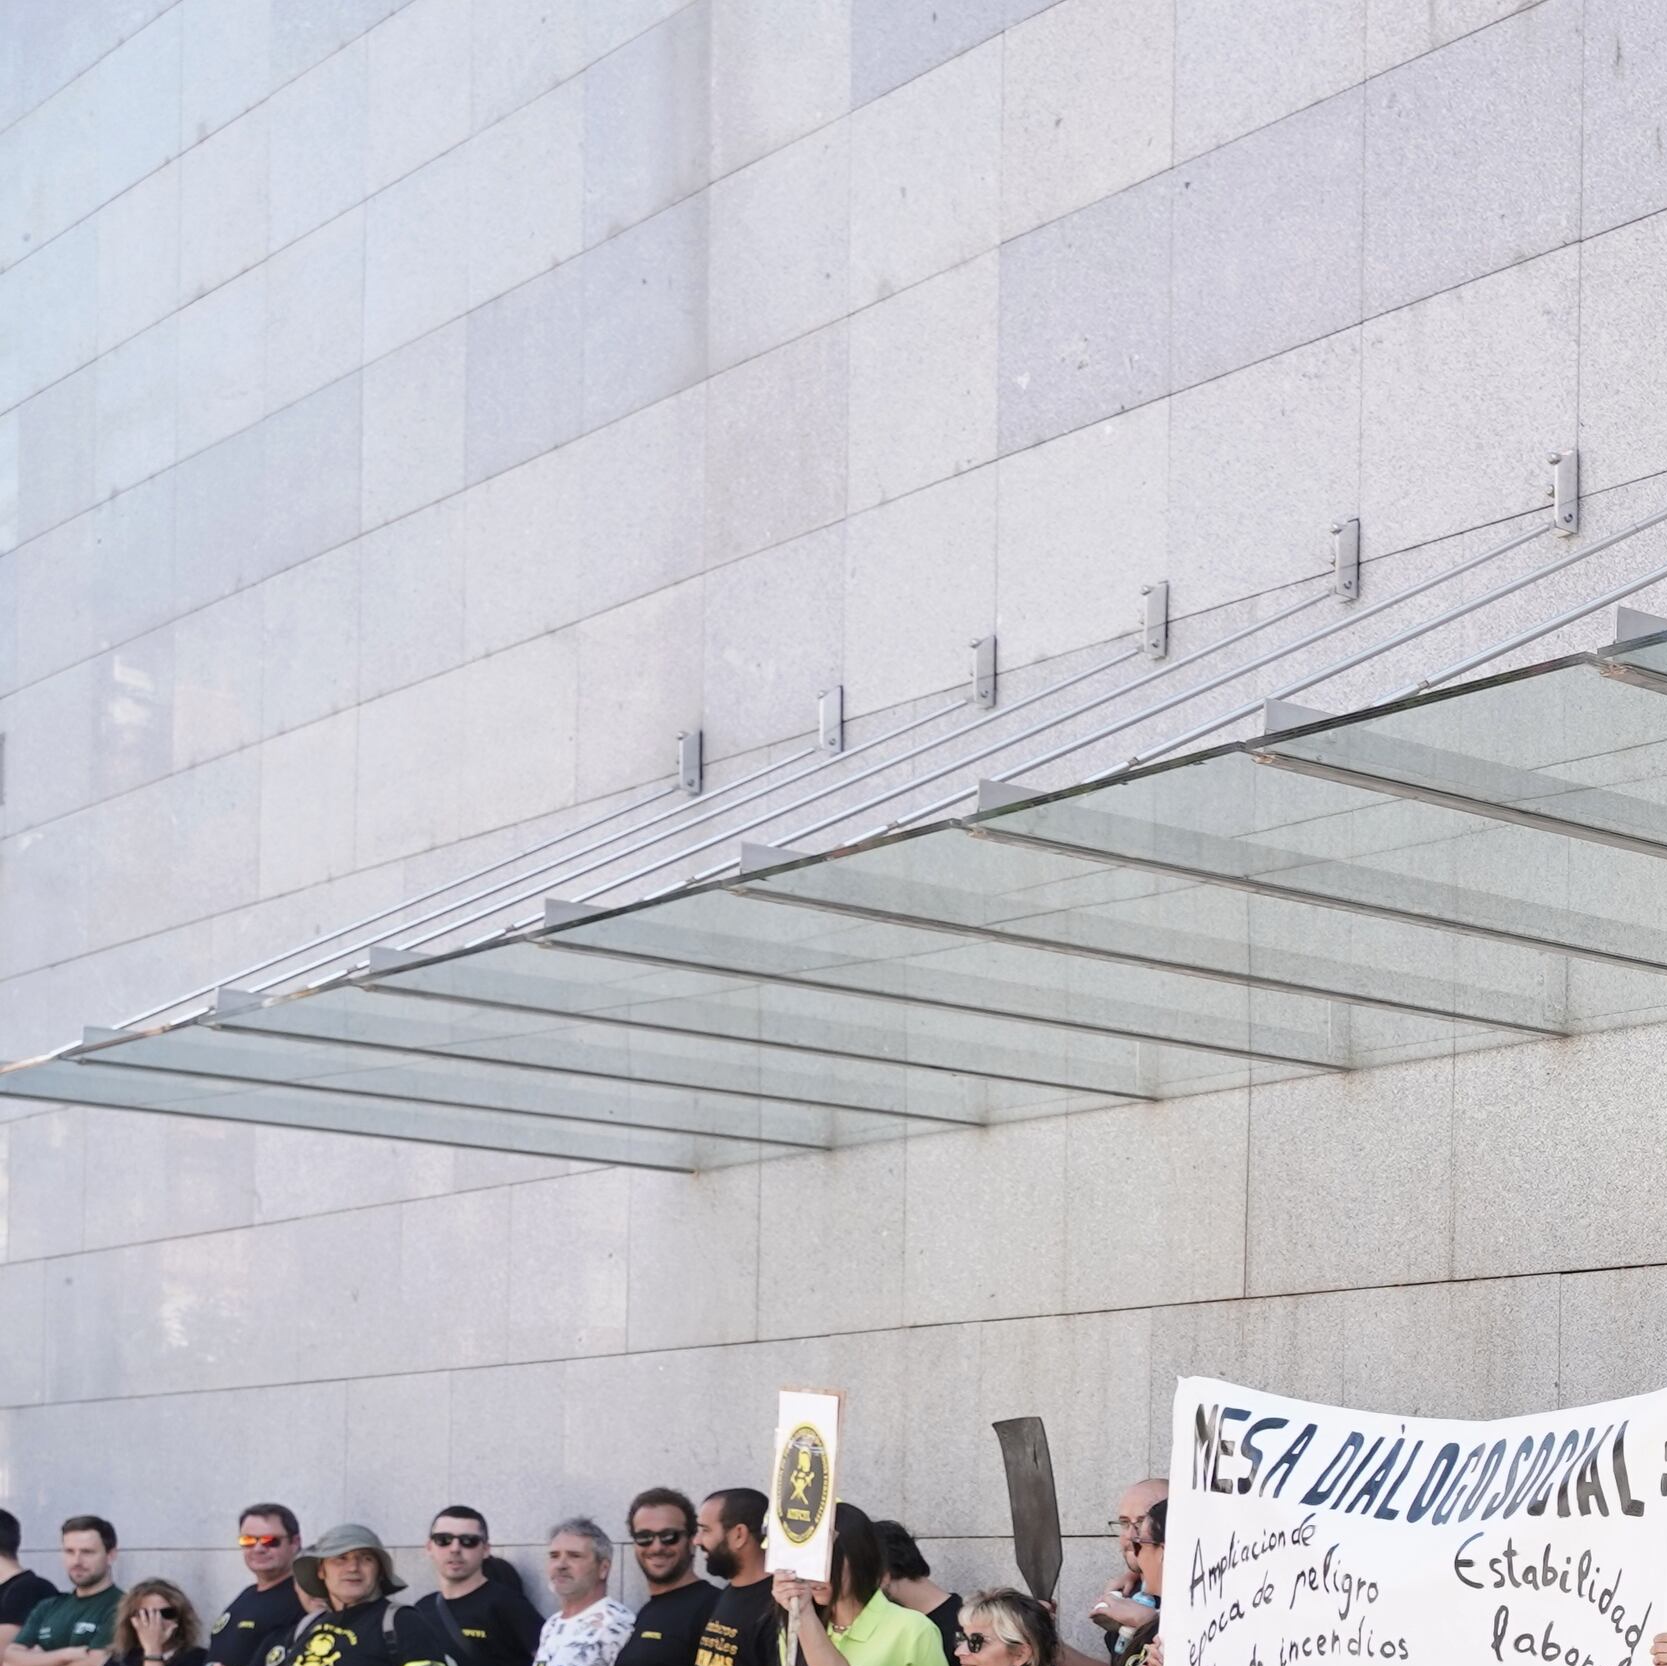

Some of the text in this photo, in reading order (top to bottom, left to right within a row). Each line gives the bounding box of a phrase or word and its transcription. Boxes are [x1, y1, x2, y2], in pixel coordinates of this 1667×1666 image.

[1191, 1402, 1318, 1499] MESA
[1251, 1569, 1275, 1609] de
[1289, 1542, 1380, 1622] peligro
[1453, 1531, 1653, 1657] Estabilidad
